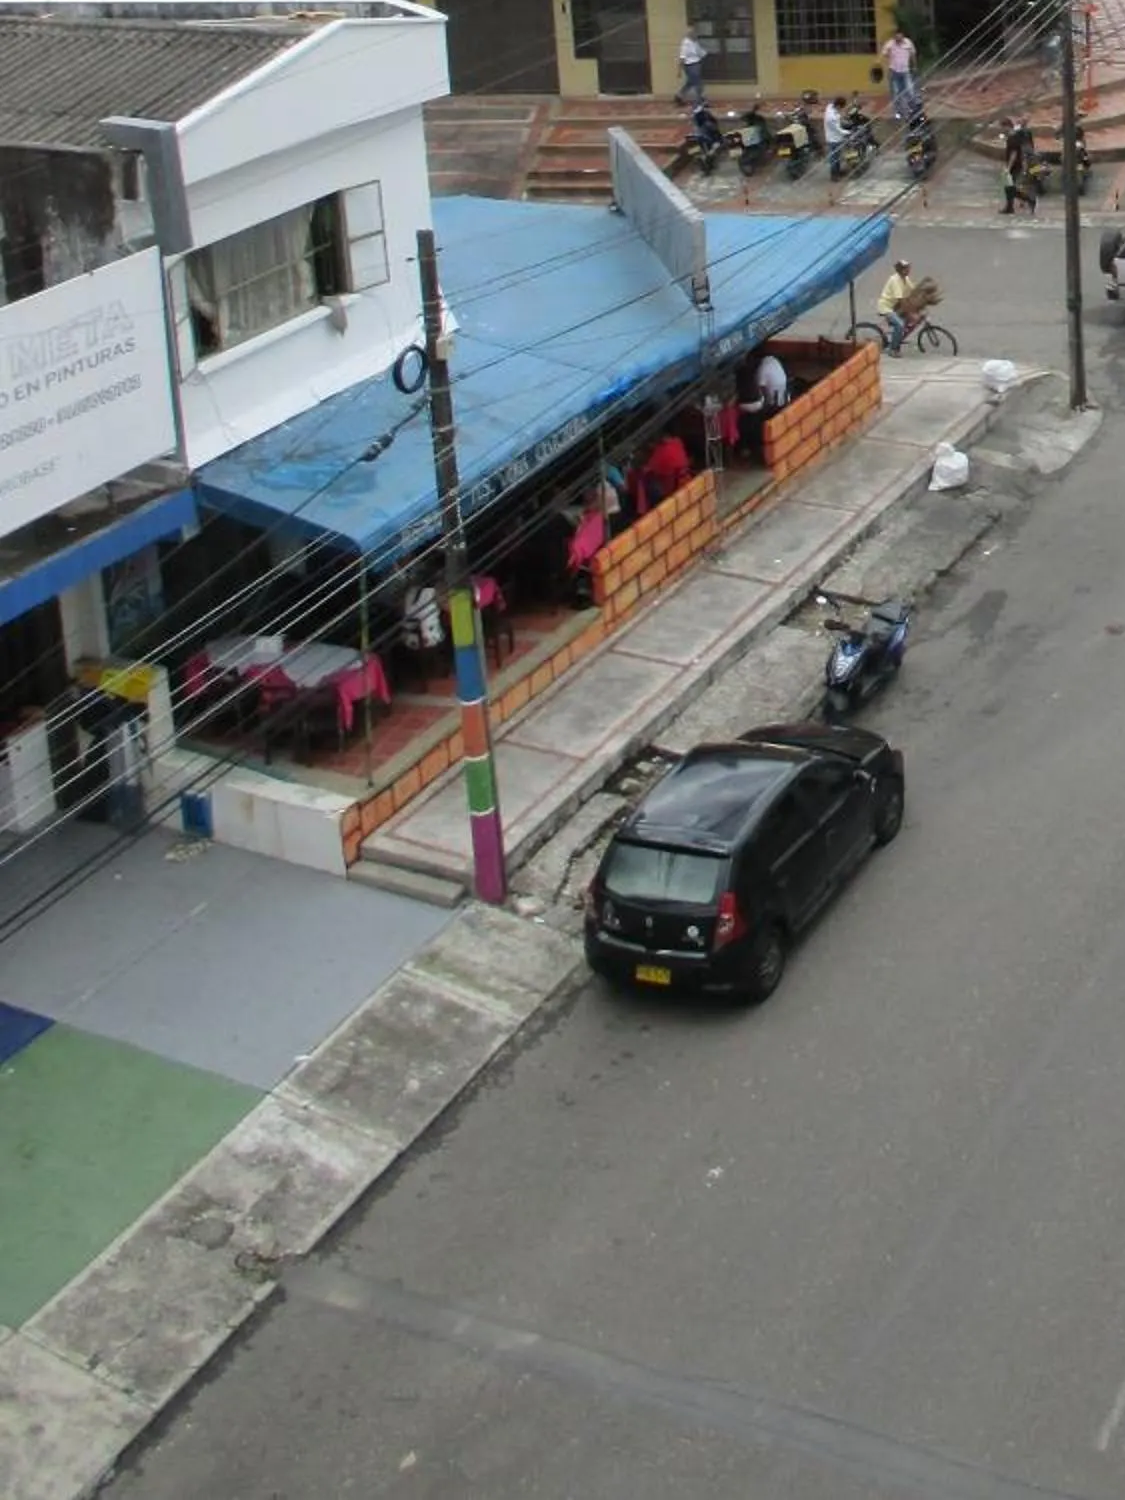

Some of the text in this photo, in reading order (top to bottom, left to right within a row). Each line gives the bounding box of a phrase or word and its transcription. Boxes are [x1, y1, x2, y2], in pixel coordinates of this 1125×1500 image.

[9, 299, 136, 382] META
[14, 378, 42, 402] EN
[44, 336, 137, 389] PINTURAS
